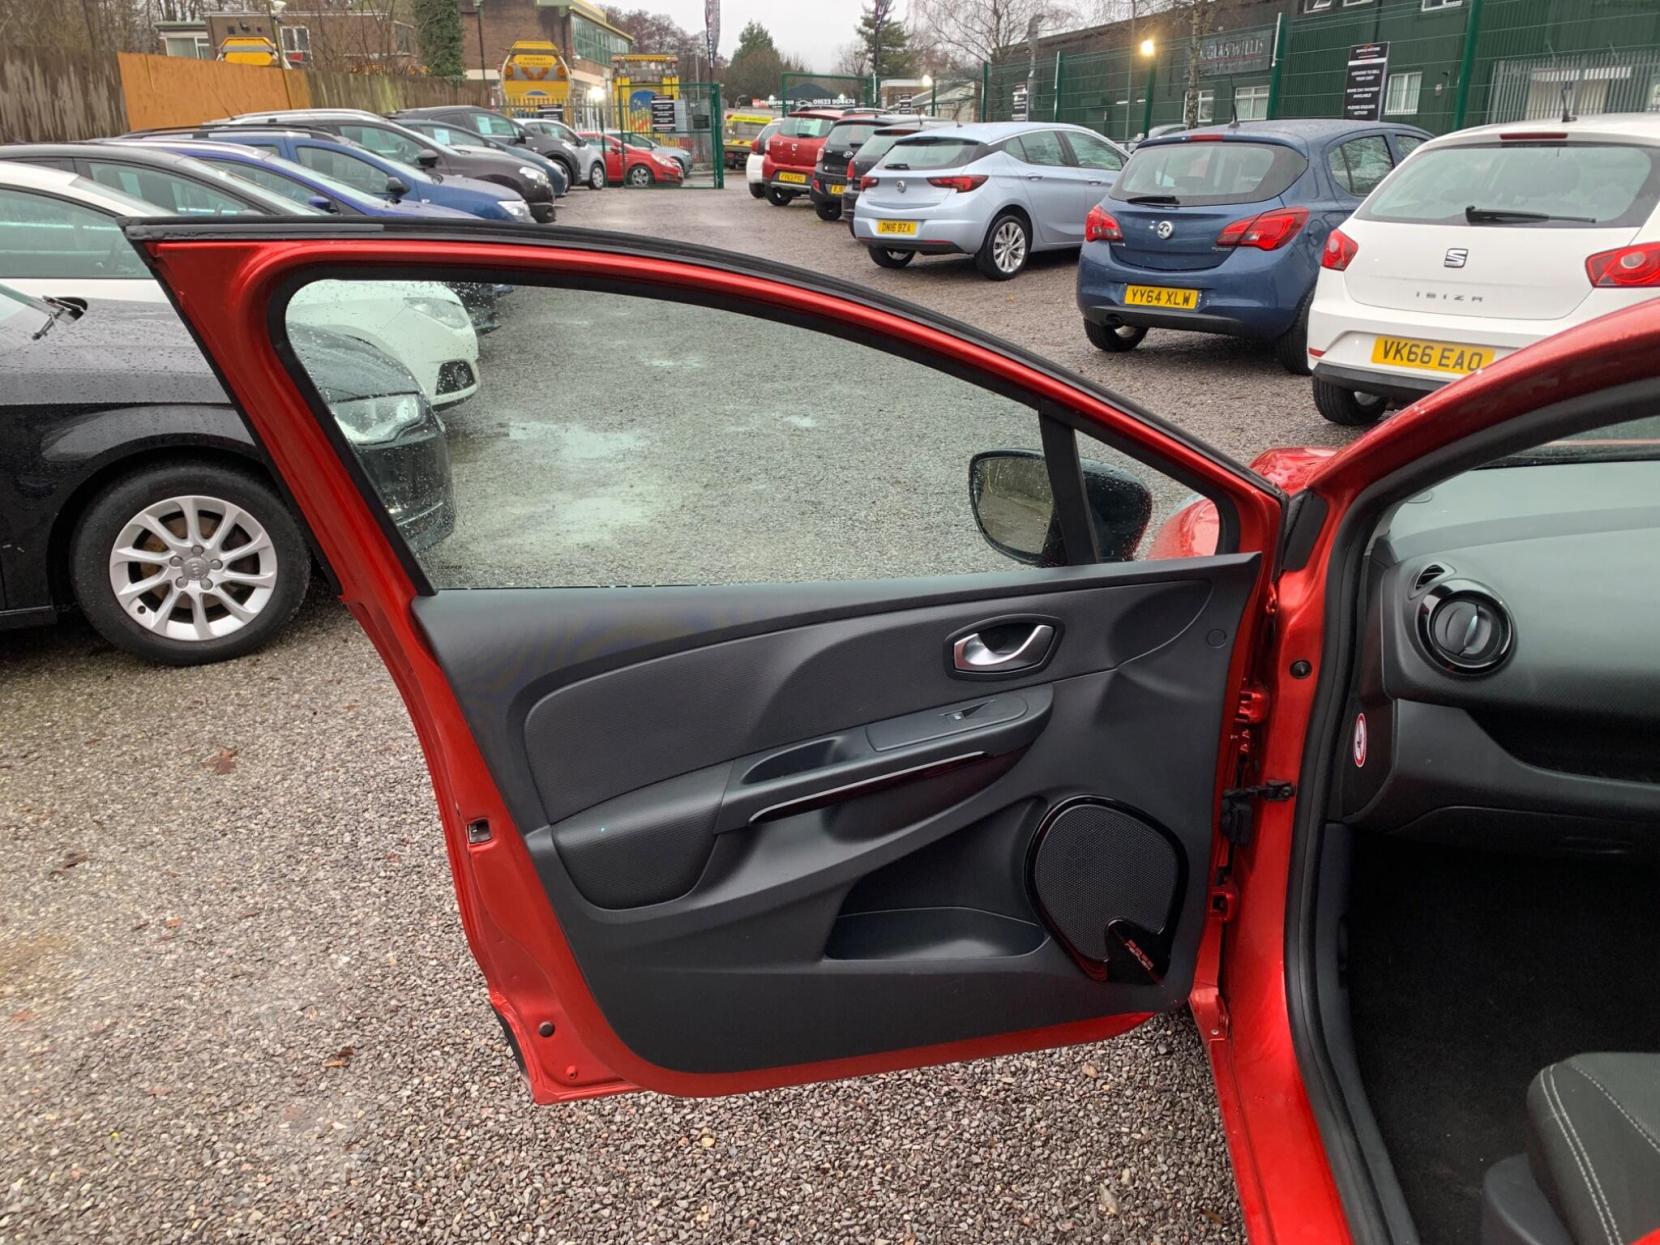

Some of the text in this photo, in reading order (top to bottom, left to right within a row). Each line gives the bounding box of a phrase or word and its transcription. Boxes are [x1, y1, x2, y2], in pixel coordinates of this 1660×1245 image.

[1131, 287, 1192, 306] YY64 XLW
[1416, 291, 1484, 302] IBIZA
[1383, 339, 1484, 372] VK66 EAO
